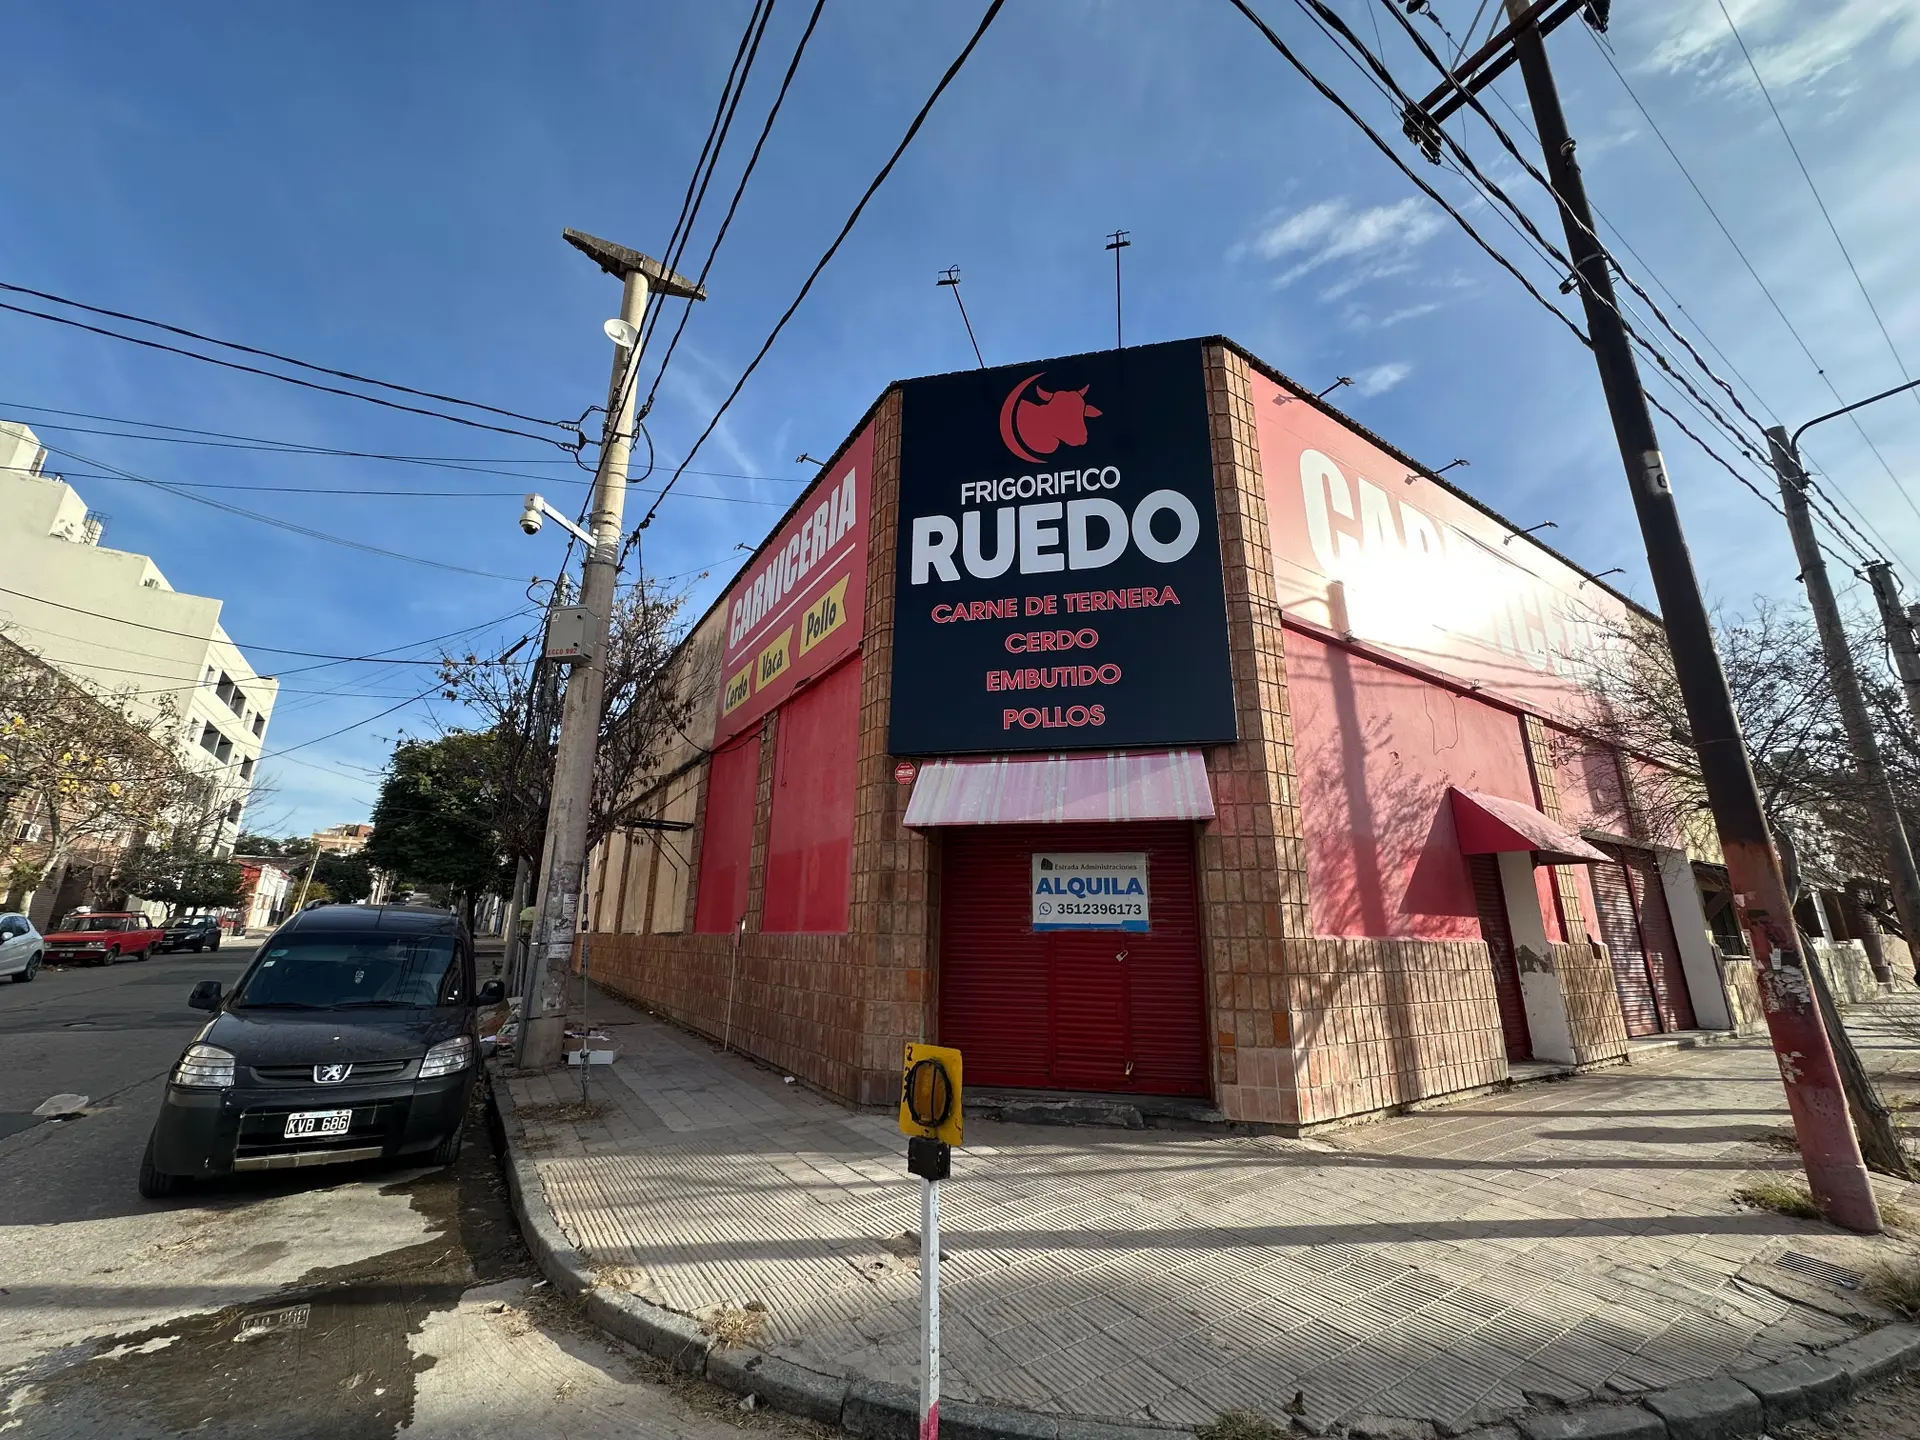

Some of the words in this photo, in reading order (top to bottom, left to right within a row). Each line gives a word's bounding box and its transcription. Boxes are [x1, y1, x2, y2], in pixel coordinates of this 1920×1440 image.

[961, 466, 1121, 505] FRIGORIFICO
[911, 489, 1200, 585] RUEDO
[729, 467, 856, 650] CARNICERIA
[931, 598, 1018, 624] CARNE
[1025, 595, 1058, 616] DE
[1063, 585, 1181, 614] TERNERA
[725, 677, 748, 712] Cerdo
[761, 648, 784, 682] Vaca
[805, 596, 837, 647] Pollo
[1004, 627, 1099, 654] CERDO
[986, 663, 1122, 692] EMBUTIDO
[1003, 704, 1106, 730] POLLOS
[1080, 863, 1138, 872] Administraciones
[1035, 877, 1144, 899] ALQUILA
[1057, 903, 1142, 915] 3512396173
[288, 1118, 315, 1134] KVB
[322, 1116, 348, 1131] 686
